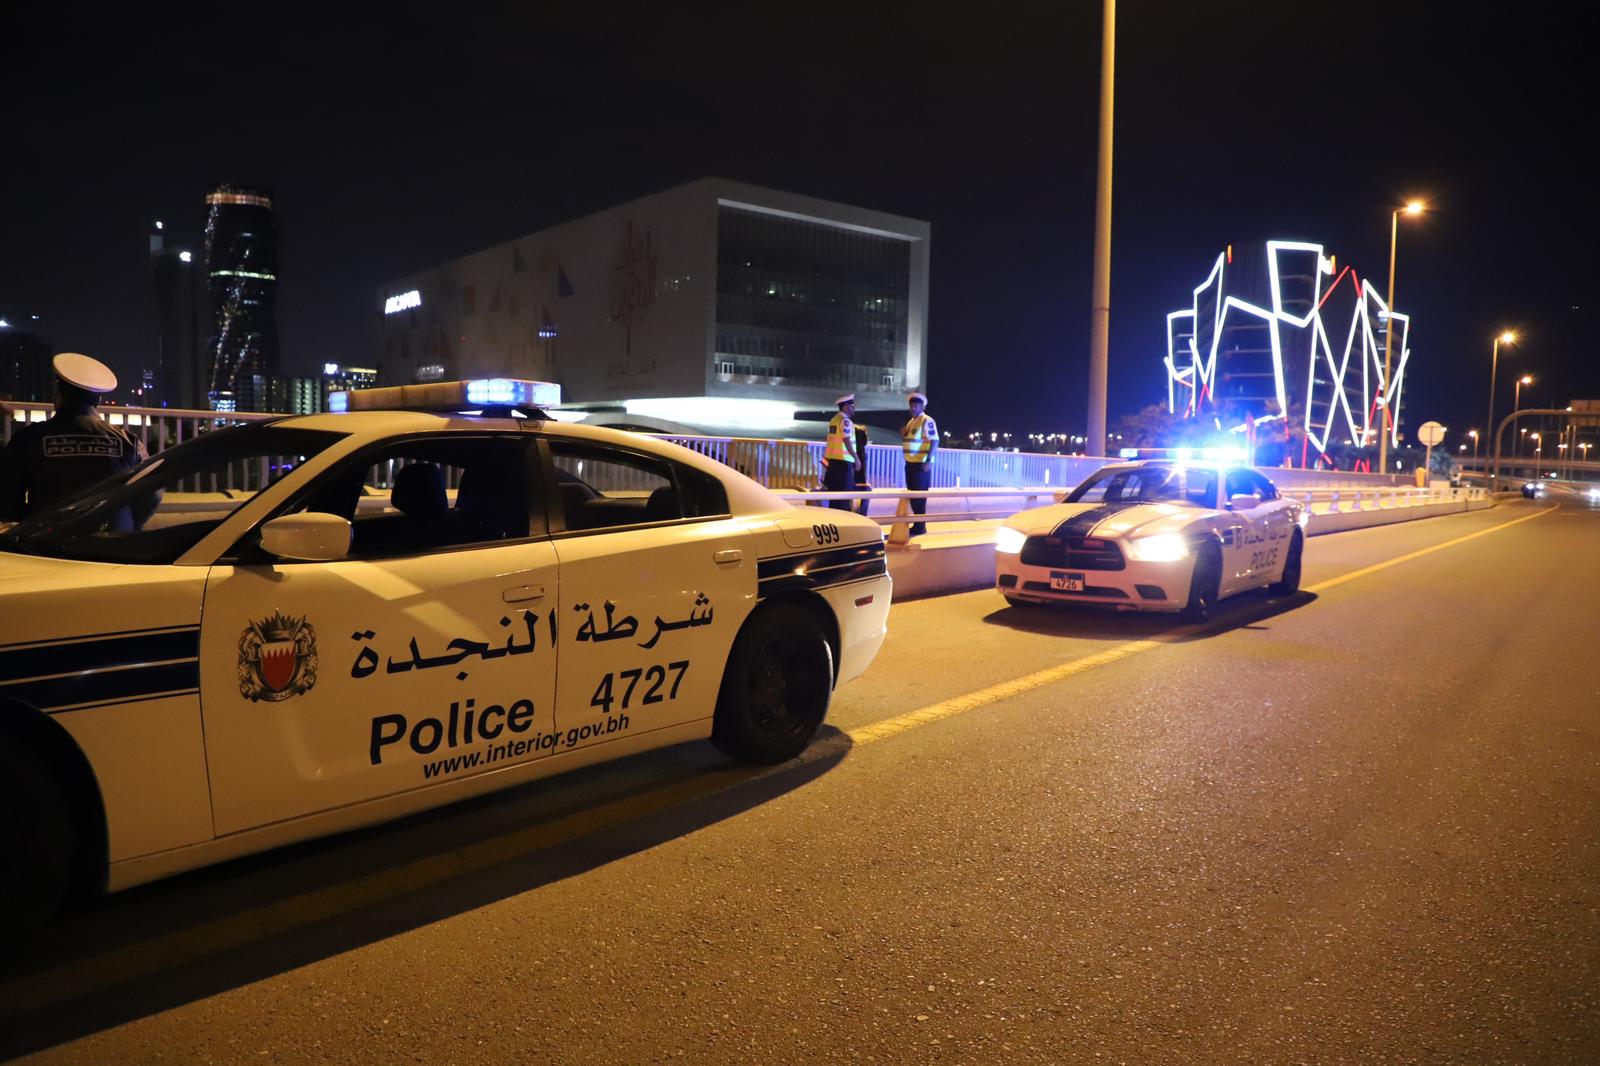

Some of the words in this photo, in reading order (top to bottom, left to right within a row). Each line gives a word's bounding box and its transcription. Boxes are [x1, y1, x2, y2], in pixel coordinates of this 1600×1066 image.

[47, 446, 120, 455] POLICE
[812, 523, 840, 545] 999
[1056, 578, 1077, 590] 4726
[350, 608, 558, 682] النجدة
[572, 592, 714, 650] شرطة
[589, 660, 691, 714] 4727
[369, 697, 536, 765] Police
[422, 713, 630, 779] www.interior.gov.bh
